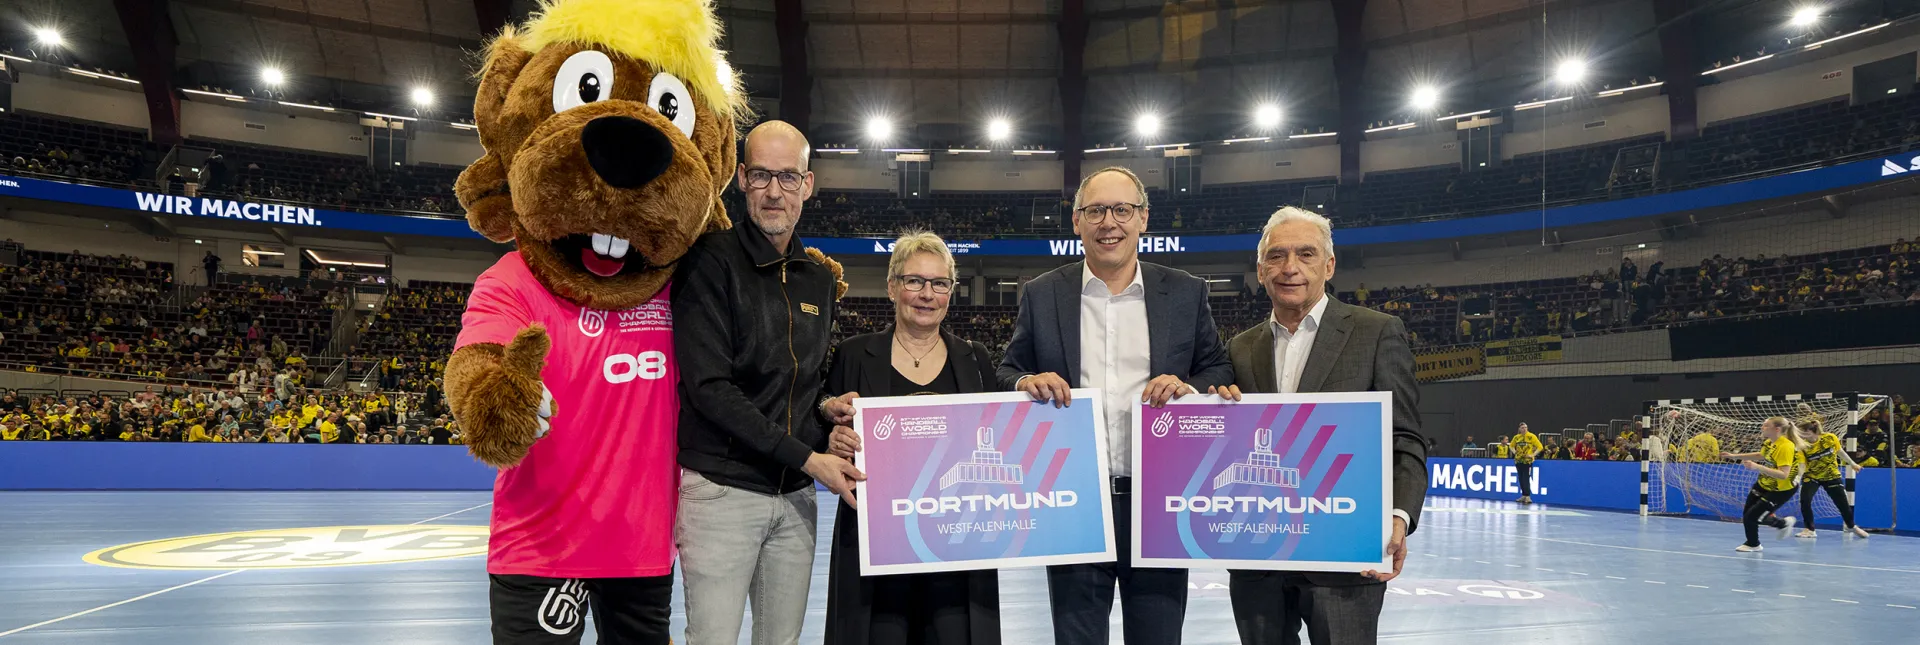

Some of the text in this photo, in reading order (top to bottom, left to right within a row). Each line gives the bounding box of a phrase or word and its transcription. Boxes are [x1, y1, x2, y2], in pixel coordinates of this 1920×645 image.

[135, 191, 322, 226] WIR MACHEN.
[1137, 236, 1186, 253] HEN.
[618, 311, 673, 321] WORLD
[603, 350, 667, 384] 08
[1416, 356, 1474, 373] ORTMUND
[892, 490, 1078, 516] DORTMUND
[1165, 495, 1357, 514] DORTMUND
[936, 518, 1037, 535] WESTFALENHALLE
[1208, 522, 1310, 535] WESTFALENHALLE
[157, 528, 490, 554] BVB
[216, 550, 362, 563] 09
